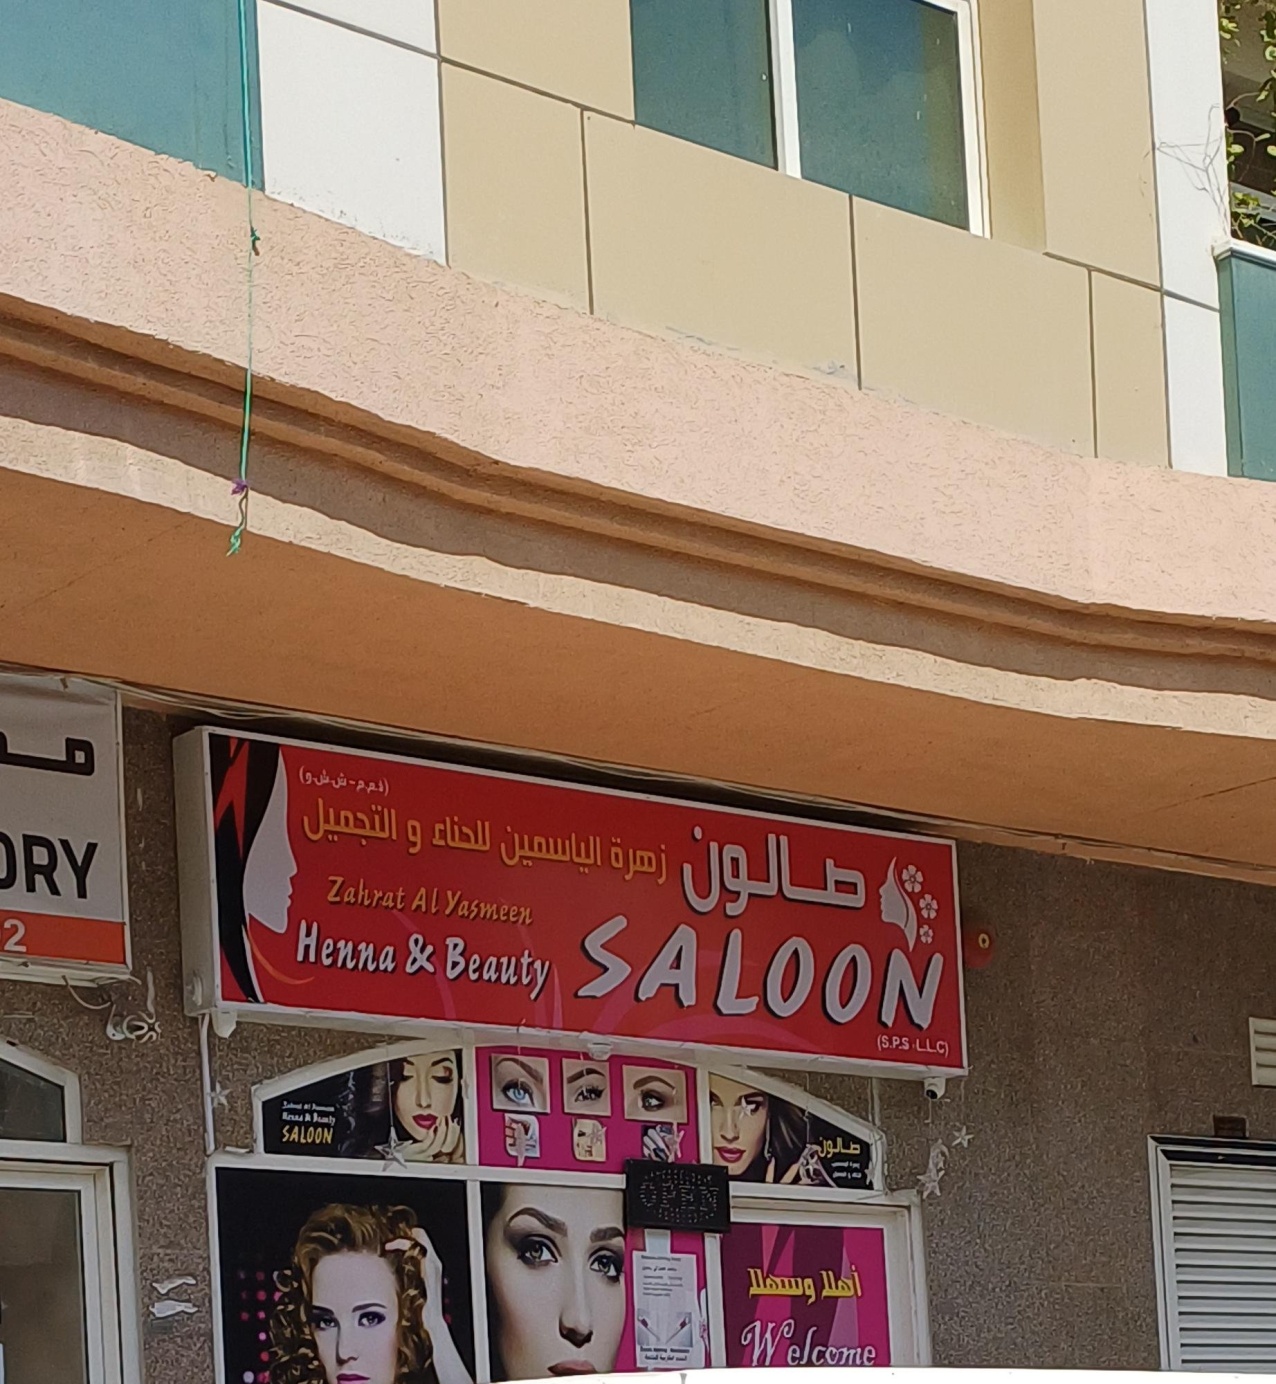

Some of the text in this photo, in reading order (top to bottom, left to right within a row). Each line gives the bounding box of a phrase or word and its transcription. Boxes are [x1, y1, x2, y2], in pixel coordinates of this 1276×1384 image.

[303, 797, 667, 885] زهرة الياسمين للحناء و التجميل
[682, 825, 866, 917] صالون
[327, 875, 533, 925] Zahrat Al Yasmeen
[296, 918, 550, 1001] Henna & Beauty
[574, 914, 945, 1031] SALOON
[282, 1124, 334, 1144] SALOON
[819, 1136, 861, 1158] صالون
[747, 1264, 862, 1306] أهلا وسهلا
[741, 1318, 876, 1366] Welcome
